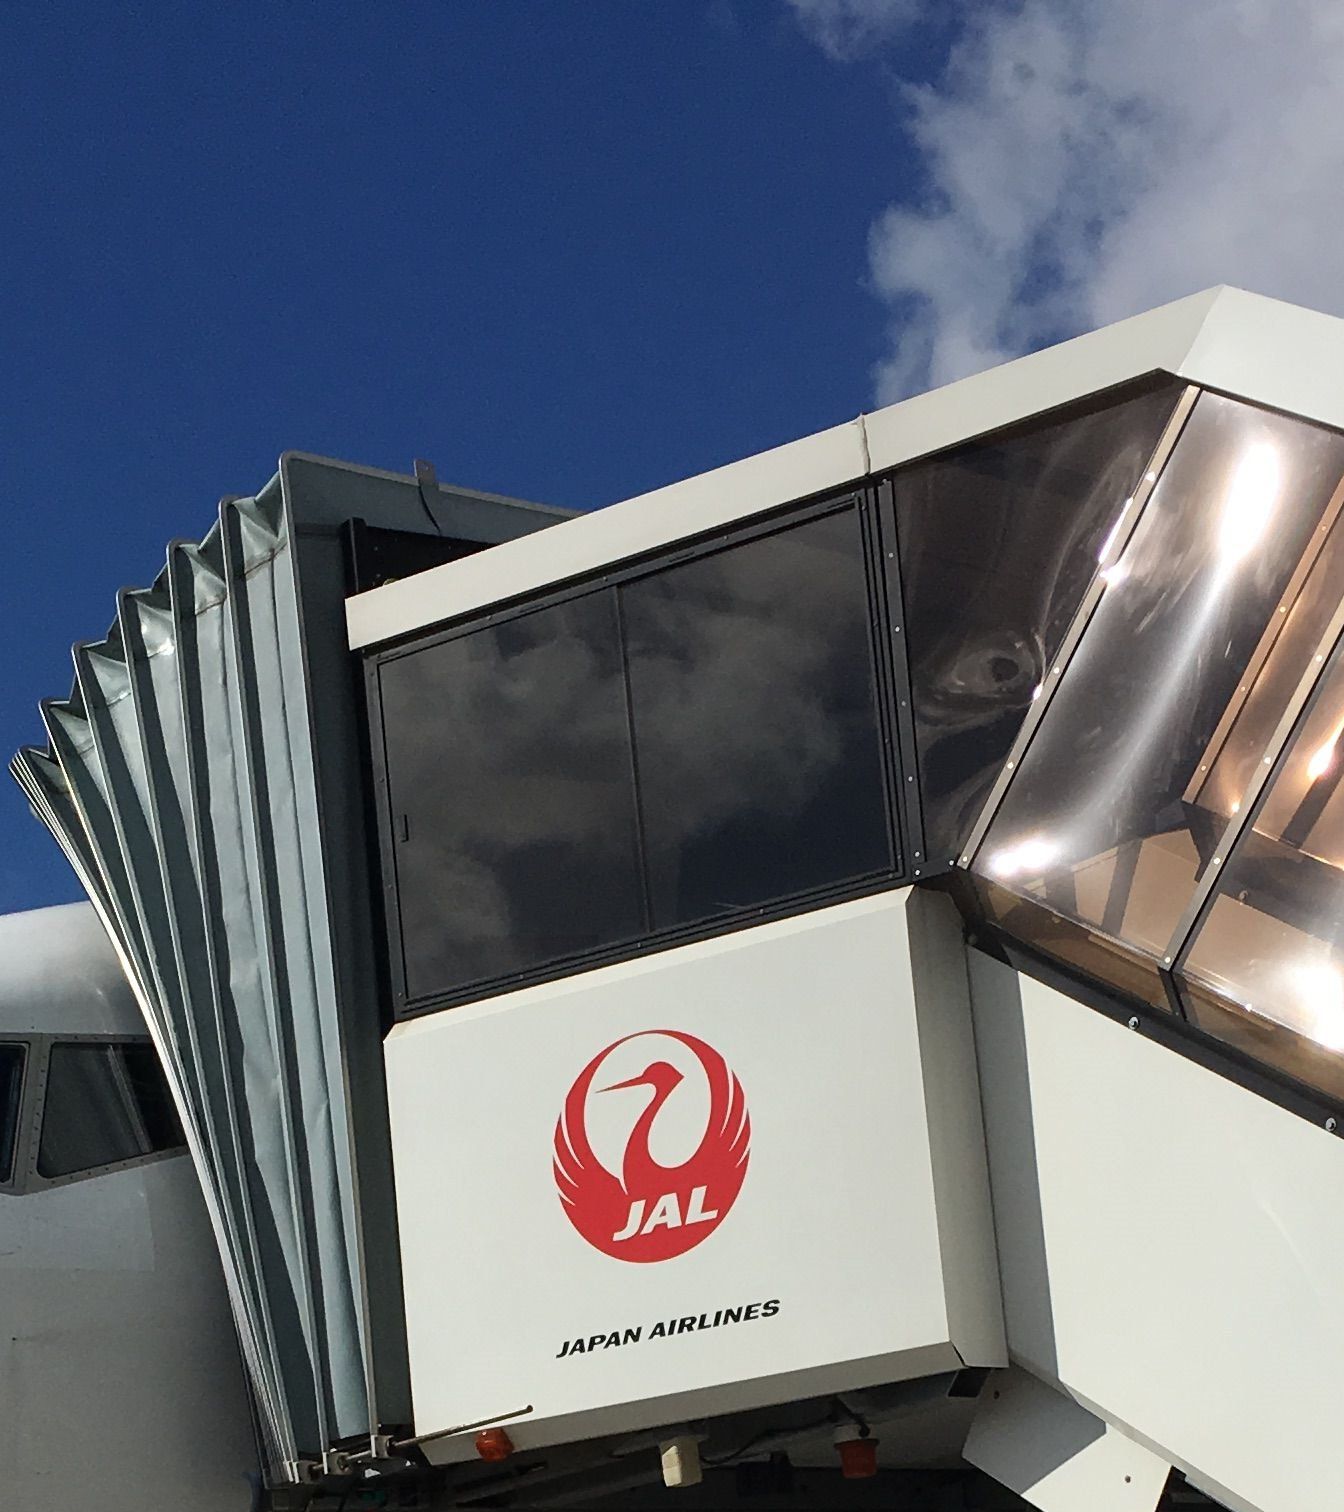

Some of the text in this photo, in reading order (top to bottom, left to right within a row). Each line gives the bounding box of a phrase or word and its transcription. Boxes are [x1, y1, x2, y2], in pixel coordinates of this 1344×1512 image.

[612, 1185, 719, 1242] JAL
[556, 1299, 781, 1359] JAPAN AIRLINES
